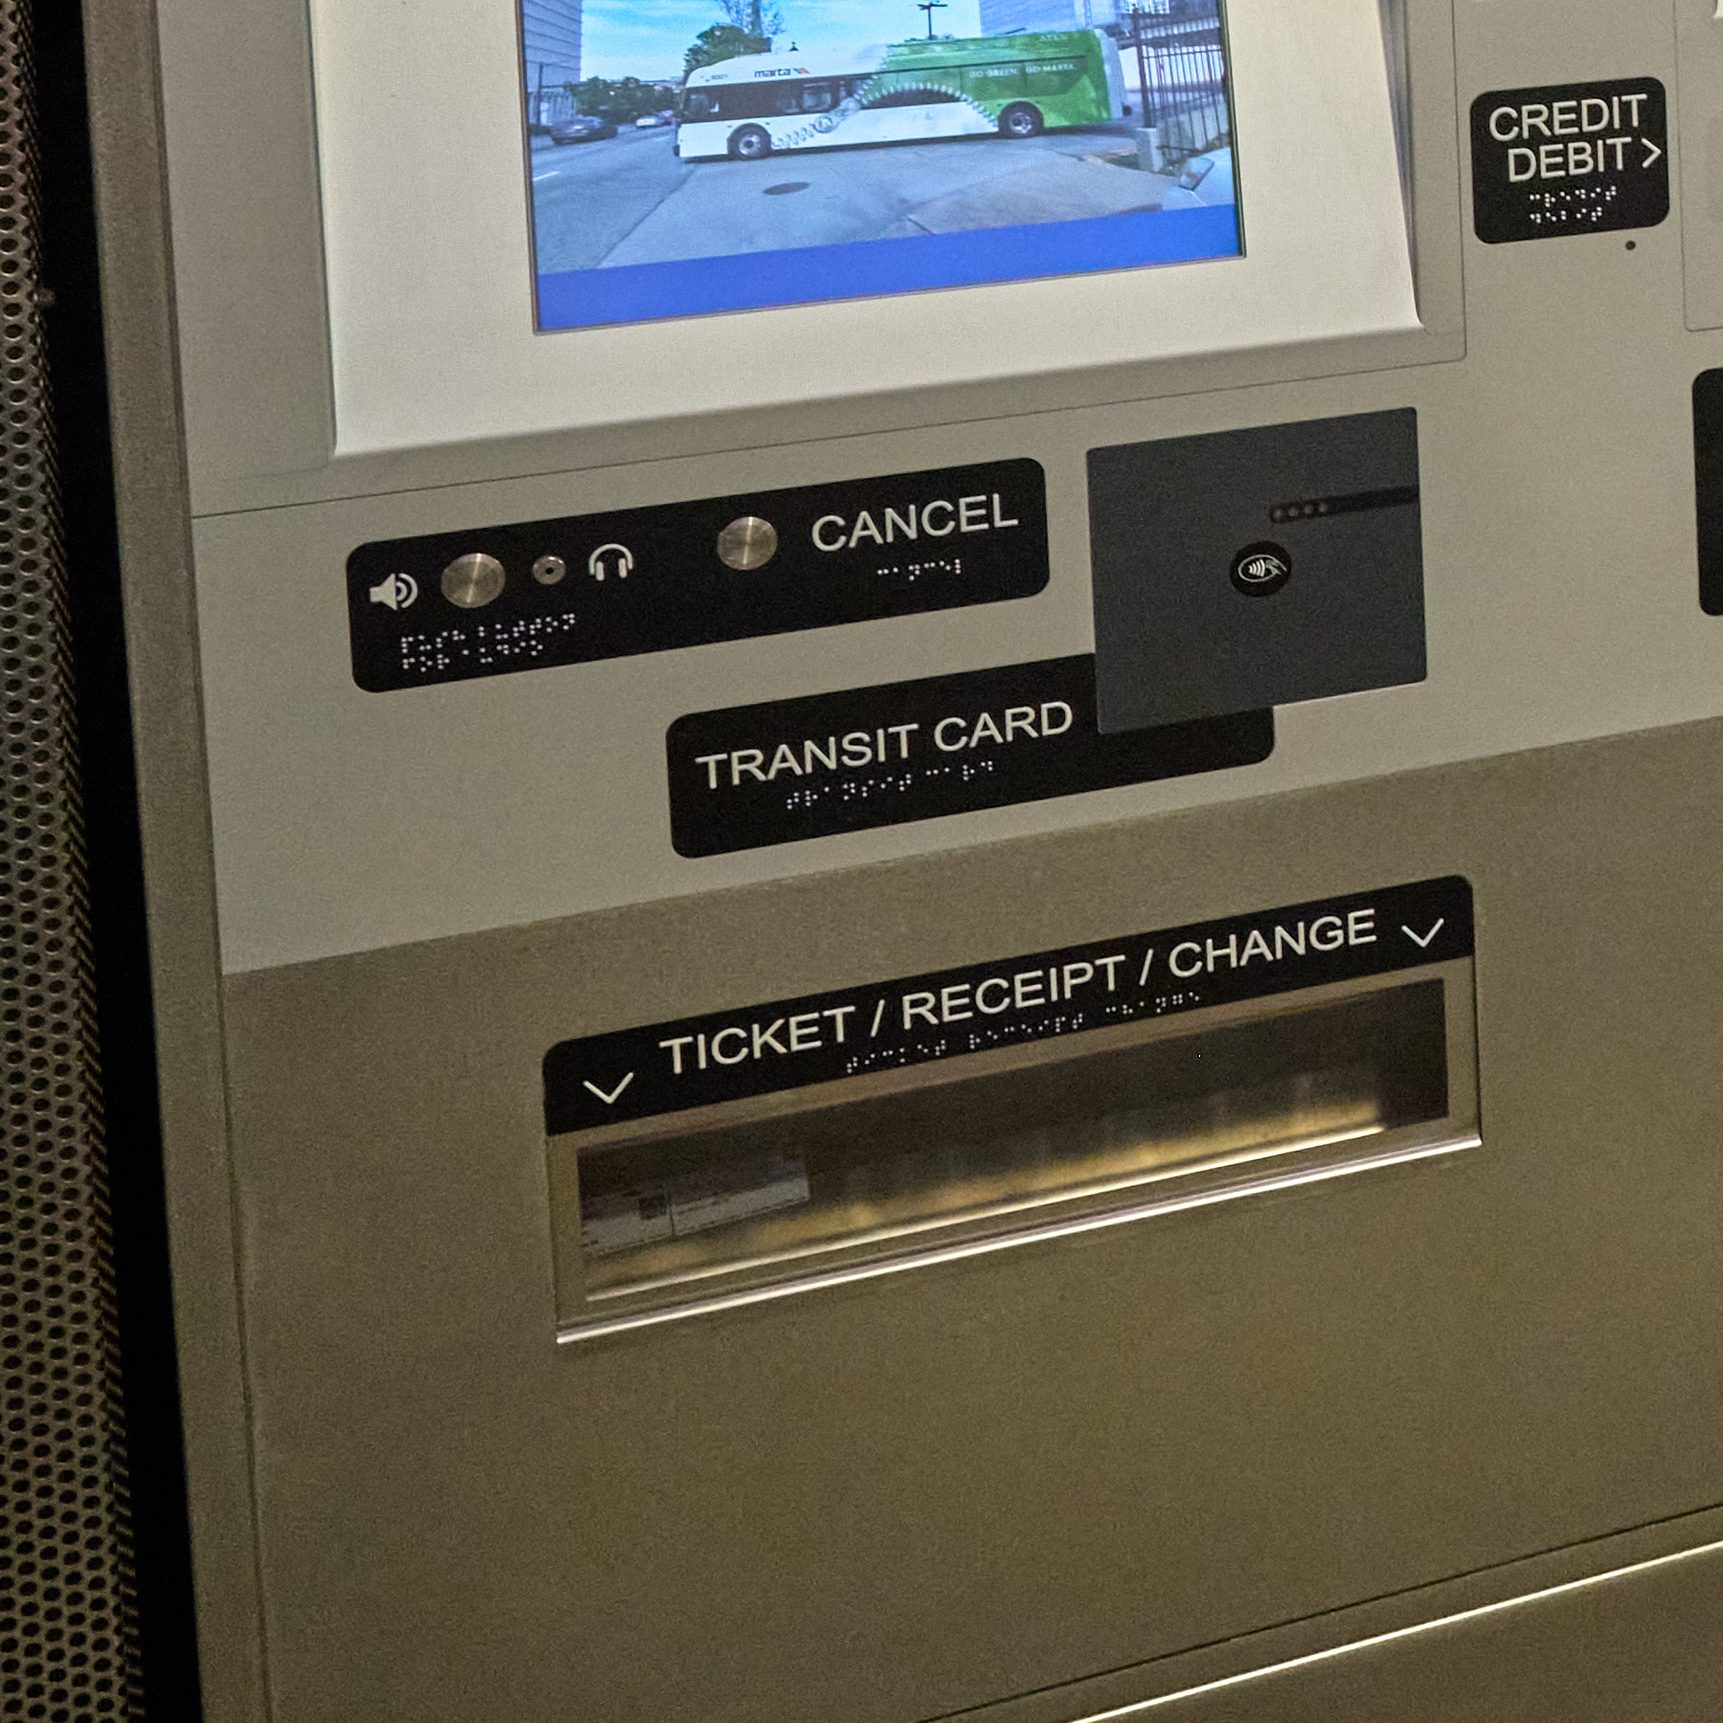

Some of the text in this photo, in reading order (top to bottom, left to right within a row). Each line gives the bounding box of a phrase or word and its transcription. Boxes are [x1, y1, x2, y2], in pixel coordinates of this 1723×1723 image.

[754, 68, 791, 78] marta
[1488, 93, 1648, 142] CREDIT
[1507, 135, 1632, 183] DEBIT
[811, 493, 1019, 552] CANCEL
[695, 723, 919, 790] TRANSIT
[934, 701, 1073, 753] CARD
[658, 1004, 857, 1075] TICKET
[870, 999, 886, 1037] /
[902, 954, 1127, 1031] RECEIPT
[1140, 948, 1154, 986] /
[1168, 908, 1378, 978] CHANGE
